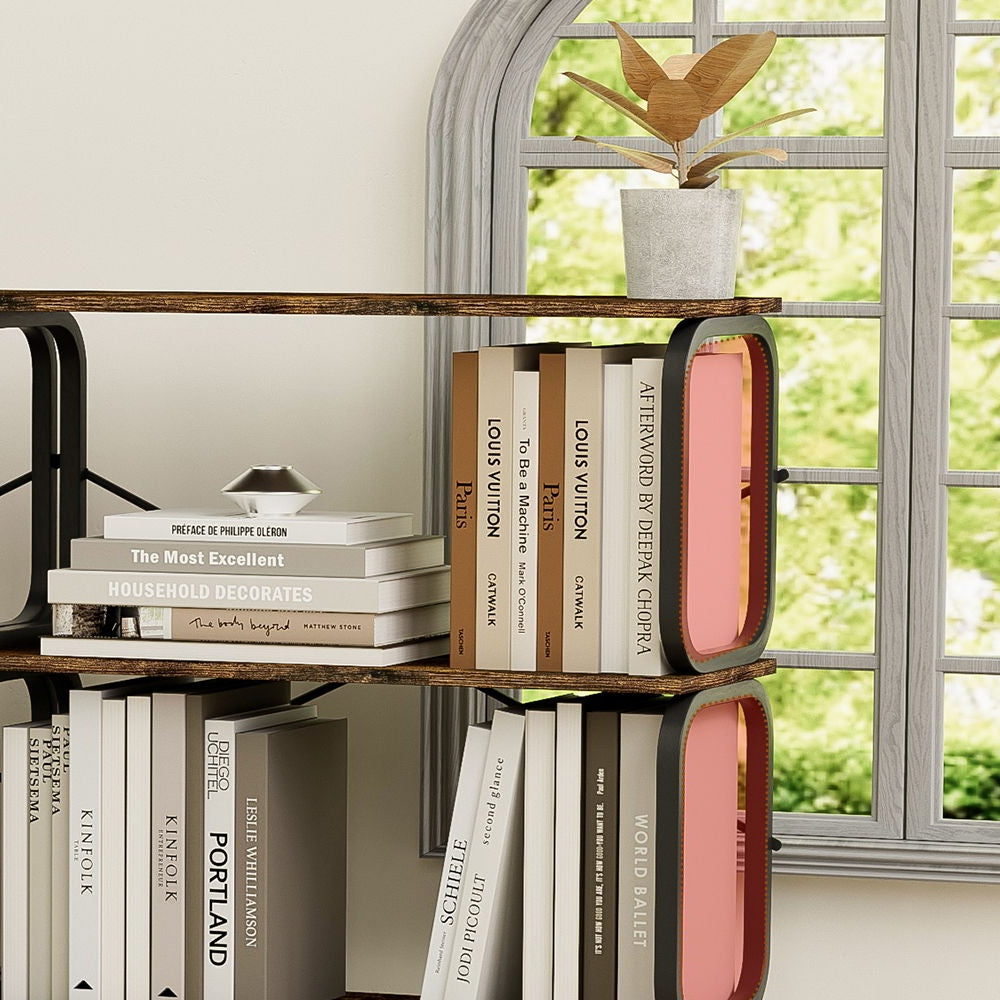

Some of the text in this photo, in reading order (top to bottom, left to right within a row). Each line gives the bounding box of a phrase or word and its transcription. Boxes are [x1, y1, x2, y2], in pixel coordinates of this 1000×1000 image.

[455, 480, 473, 529] Paris
[486, 418, 501, 538] LOUIS VUITTON
[518, 438, 530, 554] To Be a Machine
[636, 381, 655, 655] AFTERWORD BY DEEPAK CHOPRA
[130, 549, 285, 567] The Most Excellent
[171, 524, 287, 537] PRÉFACE DE PHILIPPE OLÉRON
[108, 581, 313, 602] HOUSEHOLD DECORATES
[188, 615, 290, 637] The body beyond
[487, 572, 497, 626] CATWALK
[28, 738, 40, 823] SIETSEMA
[41, 739, 53, 783] PAUL
[207, 731, 219, 800] UCHITEL
[218, 740, 230, 791] DIEGO
[482, 757, 504, 845] second glance
[80, 809, 93, 895] KINFOLK
[245, 797, 258, 947] LESLIE WHILLIAMSON
[440, 839, 468, 926] SCHIELE
[632, 814, 649, 947] WORLD BALLET
[208, 832, 228, 966] PORTLAND
[456, 872, 486, 984] JODI PICOULT
